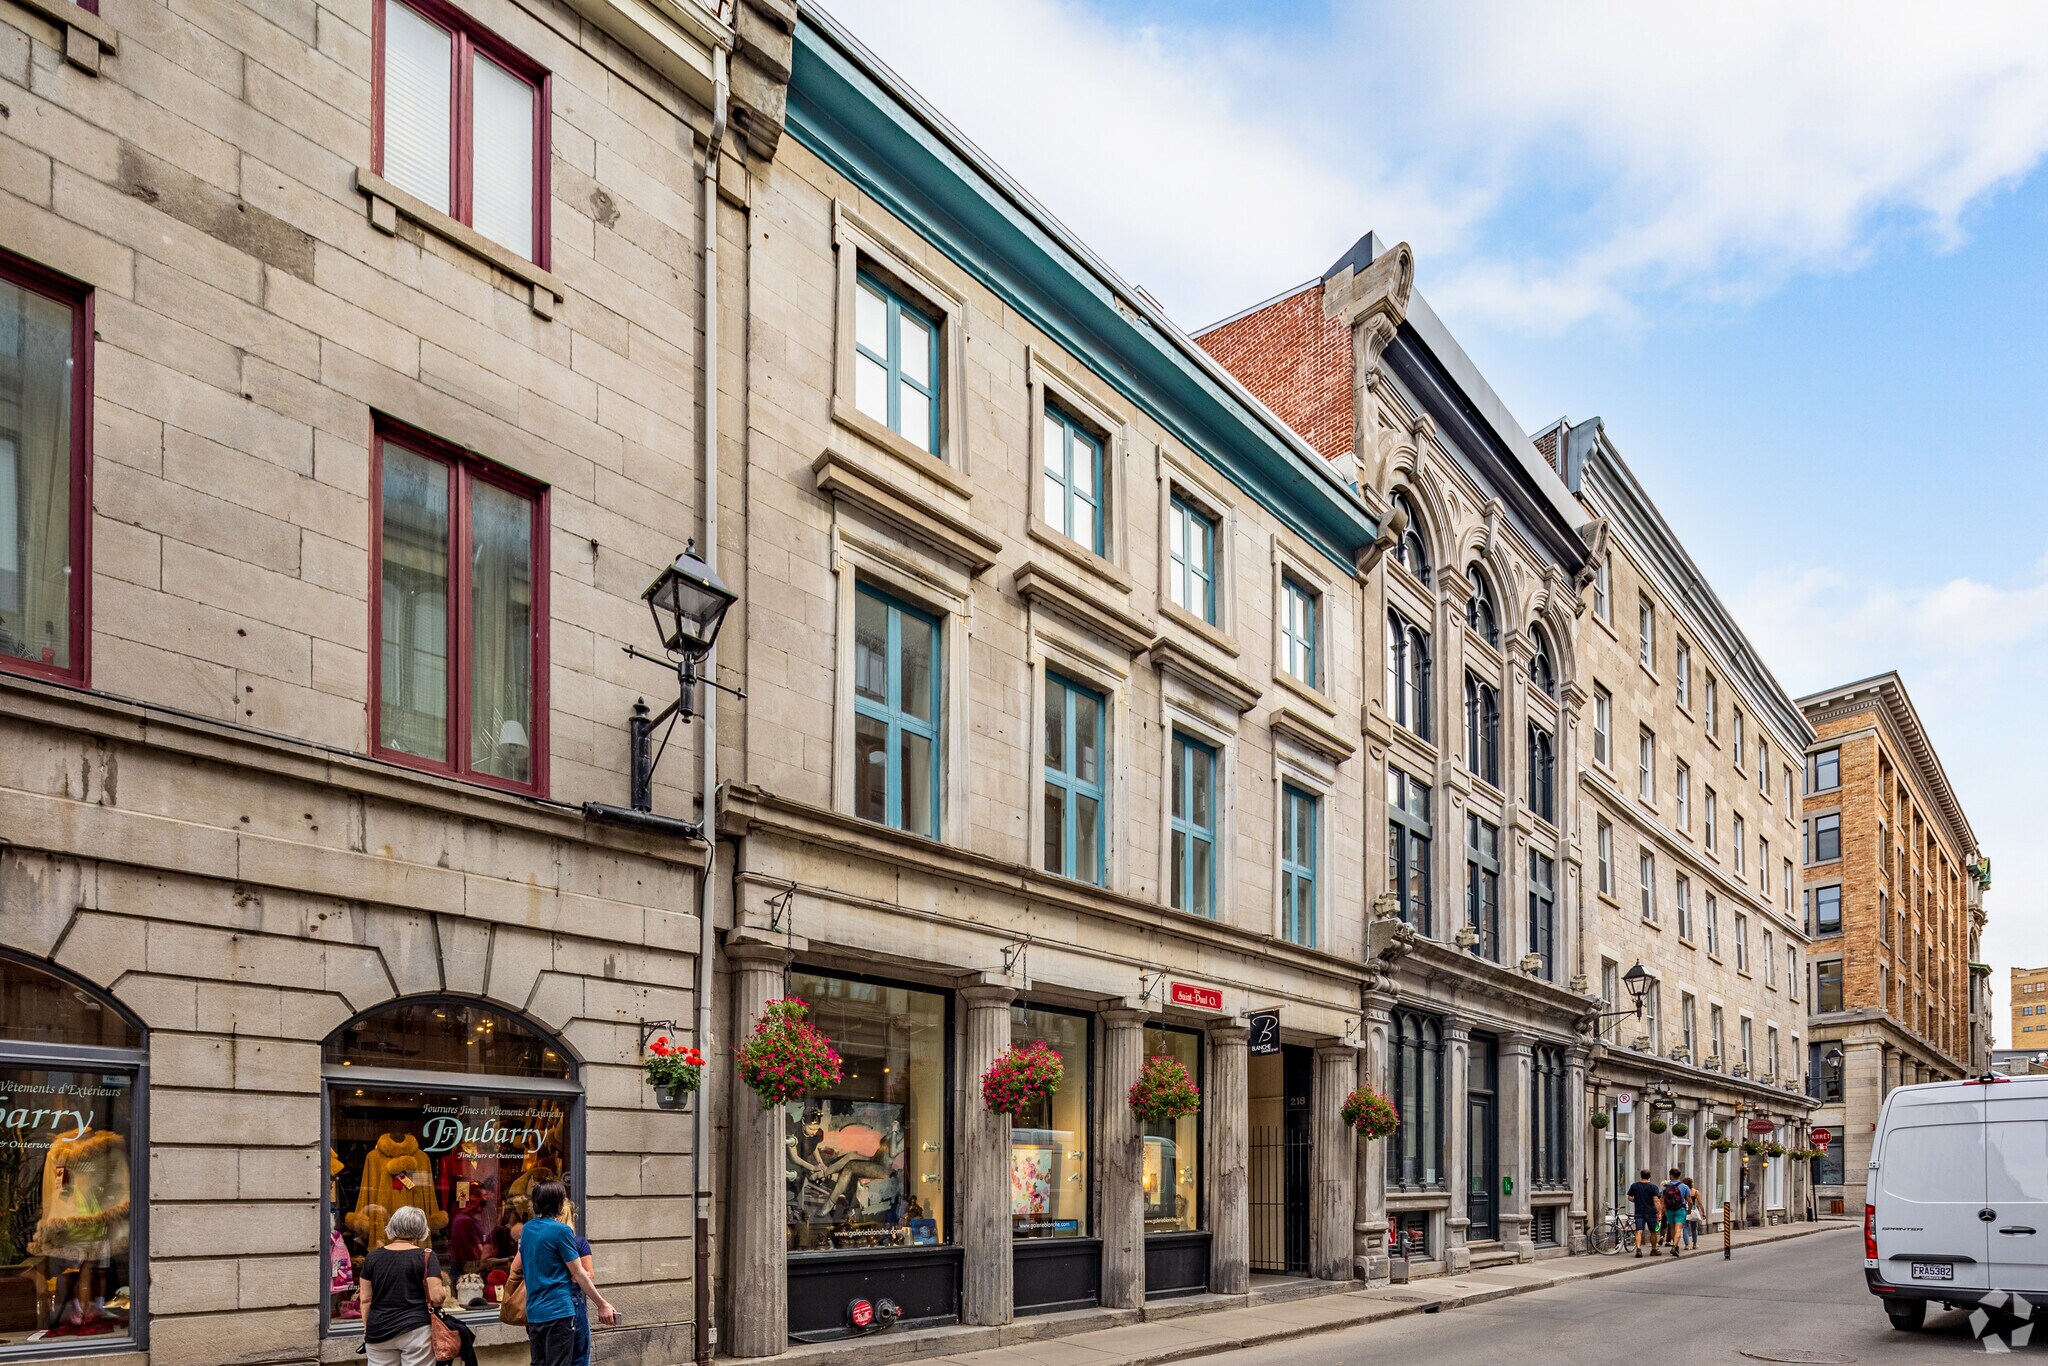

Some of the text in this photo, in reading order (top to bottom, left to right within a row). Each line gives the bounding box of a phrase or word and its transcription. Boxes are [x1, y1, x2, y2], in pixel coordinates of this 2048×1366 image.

[1177, 990, 1217, 1006] Saint-Paul O.
[1251, 1043, 1272, 1052] BLANCHE
[0, 1080, 55, 1095] Vêtements
[1290, 1096, 1306, 1106] 218
[422, 1103, 458, 1115] Fourrures
[460, 1105, 479, 1116] Fines
[480, 1107, 487, 1115] et
[488, 1107, 524, 1116] Vêtements
[422, 1116, 548, 1154] Dubarry
[1019, 1221, 1070, 1230] www.galerieblanche.com
[1913, 1266, 1952, 1276] FRA5382
